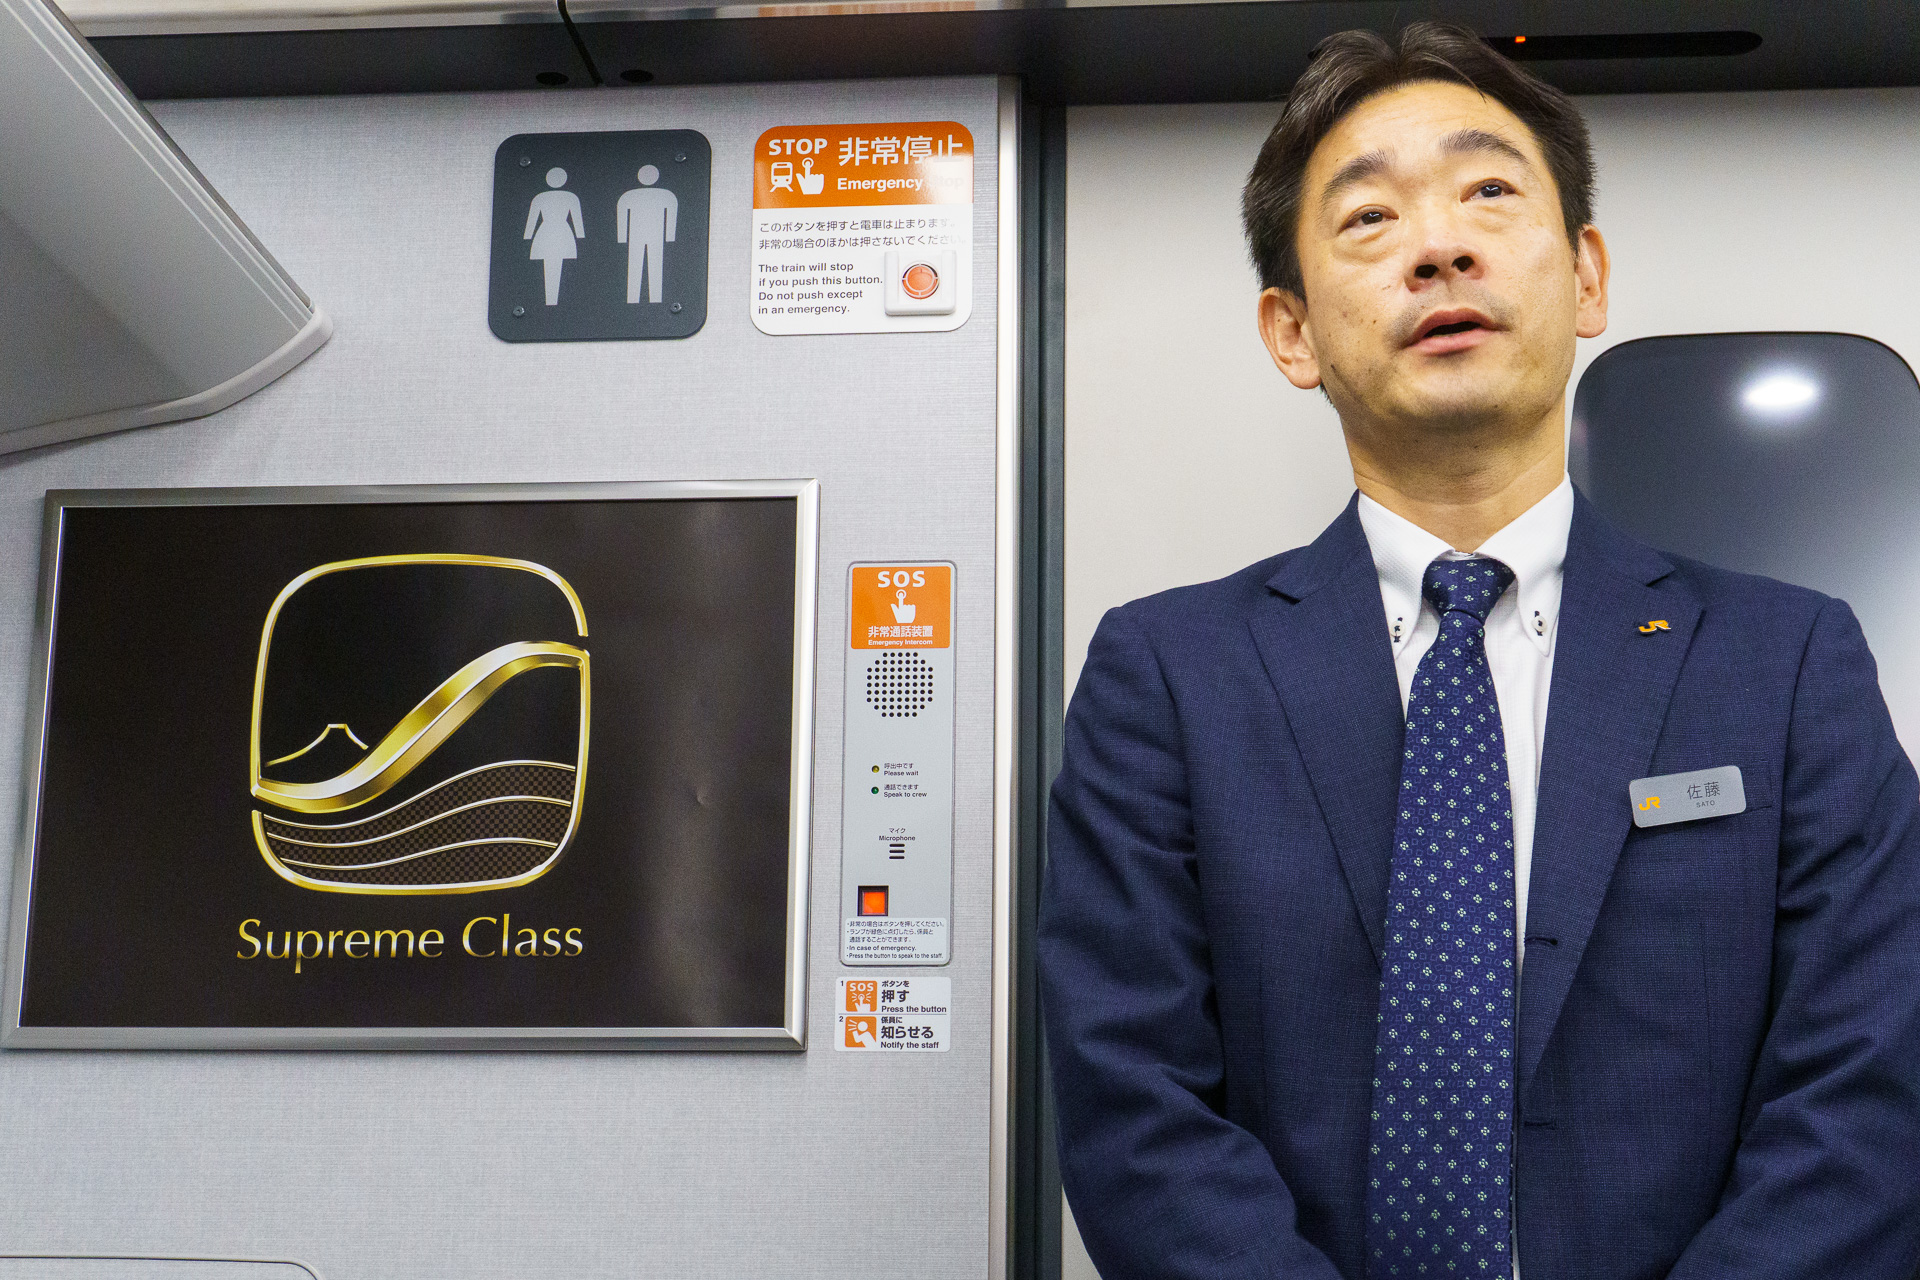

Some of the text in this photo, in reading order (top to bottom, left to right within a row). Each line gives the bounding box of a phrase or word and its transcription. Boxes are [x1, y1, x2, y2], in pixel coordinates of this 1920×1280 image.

[769, 138, 828, 156] STOP
[838, 135, 964, 166] 非常停止
[837, 178, 923, 192] Emergency
[759, 262, 854, 273] The train will stop
[759, 275, 883, 288] if you push this button.
[759, 292, 773, 301] Do
[797, 291, 824, 302] push
[827, 290, 863, 300] except
[758, 306, 768, 314] in
[787, 305, 849, 316] emergency.
[878, 571, 925, 588] SOS
[868, 626, 933, 638] 非常通話装置
[1639, 619, 1671, 633] JR
[1687, 781, 1720, 799] 佐藤
[1639, 796, 1660, 811] JR
[1696, 800, 1715, 808] SATO
[237, 913, 583, 974] Supreme Class
[850, 983, 874, 991] SOS
[882, 990, 909, 1002] 押す
[881, 1026, 933, 1039] 知らせる
